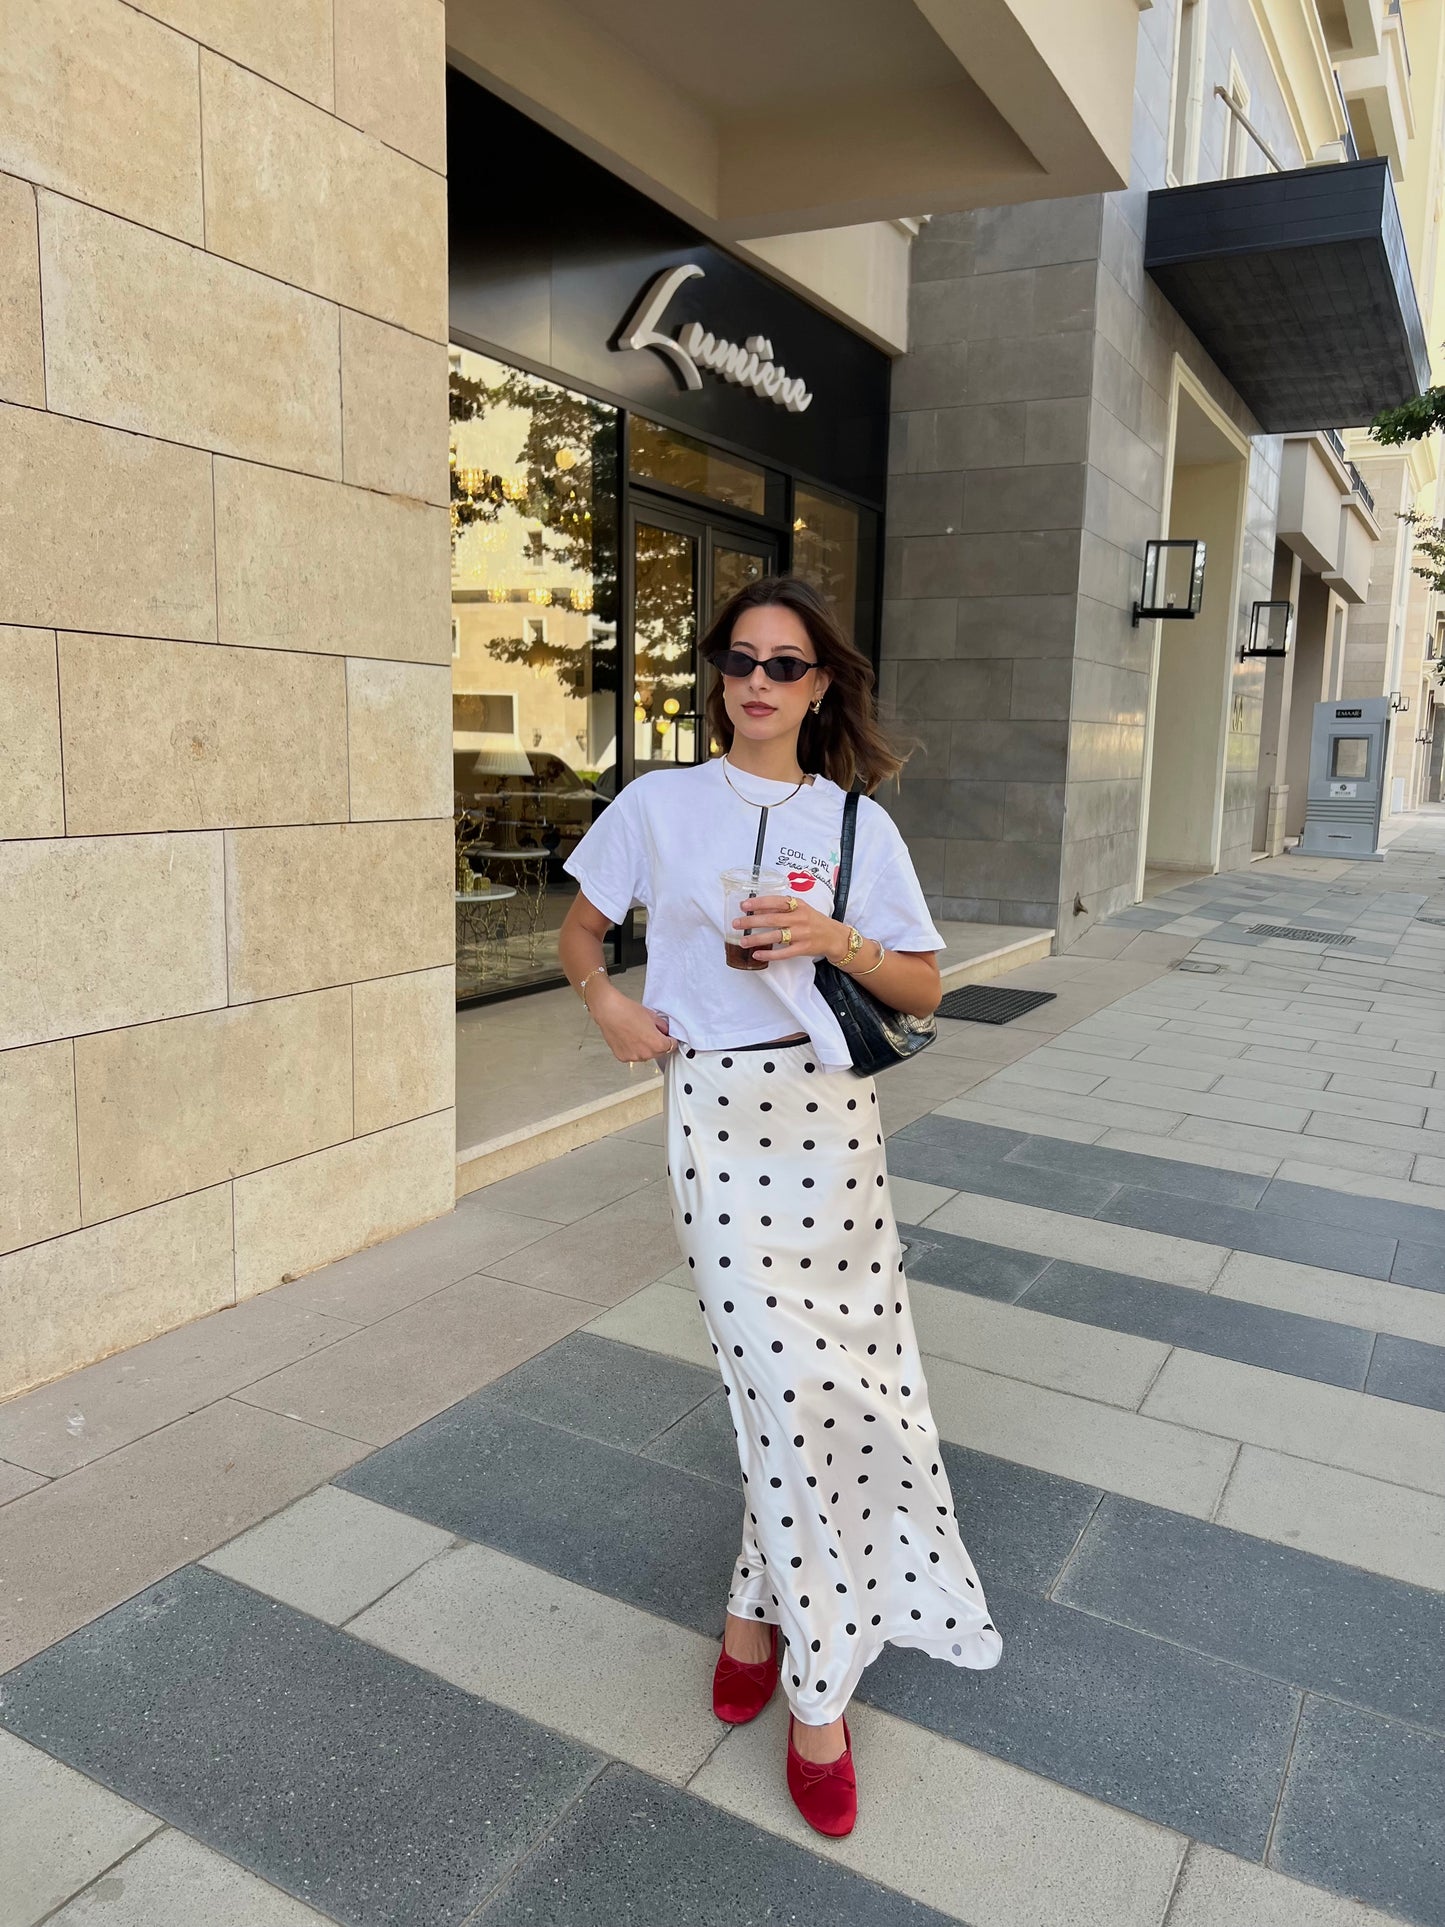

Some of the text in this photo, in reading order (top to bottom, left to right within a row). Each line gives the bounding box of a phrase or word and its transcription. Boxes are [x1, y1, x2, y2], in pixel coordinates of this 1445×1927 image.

[618, 264, 813, 412] Lumière
[780, 846, 807, 861] COOL
[811, 856, 830, 874] GIRL
